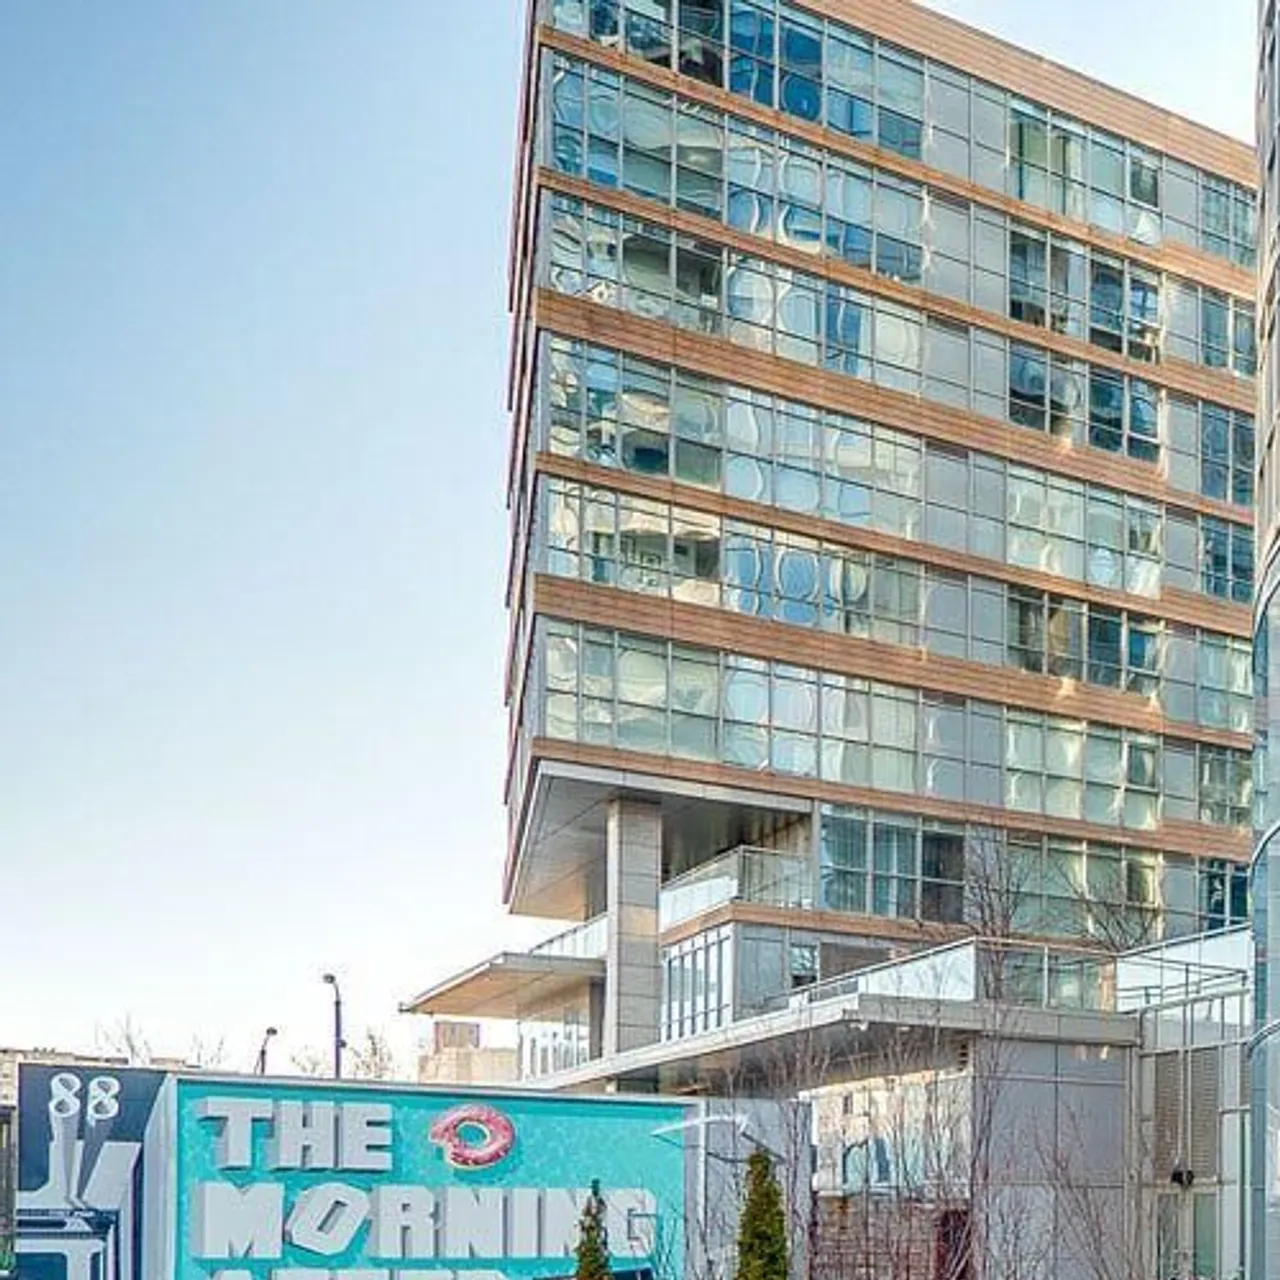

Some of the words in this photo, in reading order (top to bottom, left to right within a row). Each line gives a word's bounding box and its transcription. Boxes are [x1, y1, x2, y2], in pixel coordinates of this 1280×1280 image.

[49, 1072, 121, 1120] 88
[200, 1096, 393, 1171] THE
[193, 1181, 658, 1260] MORNING
